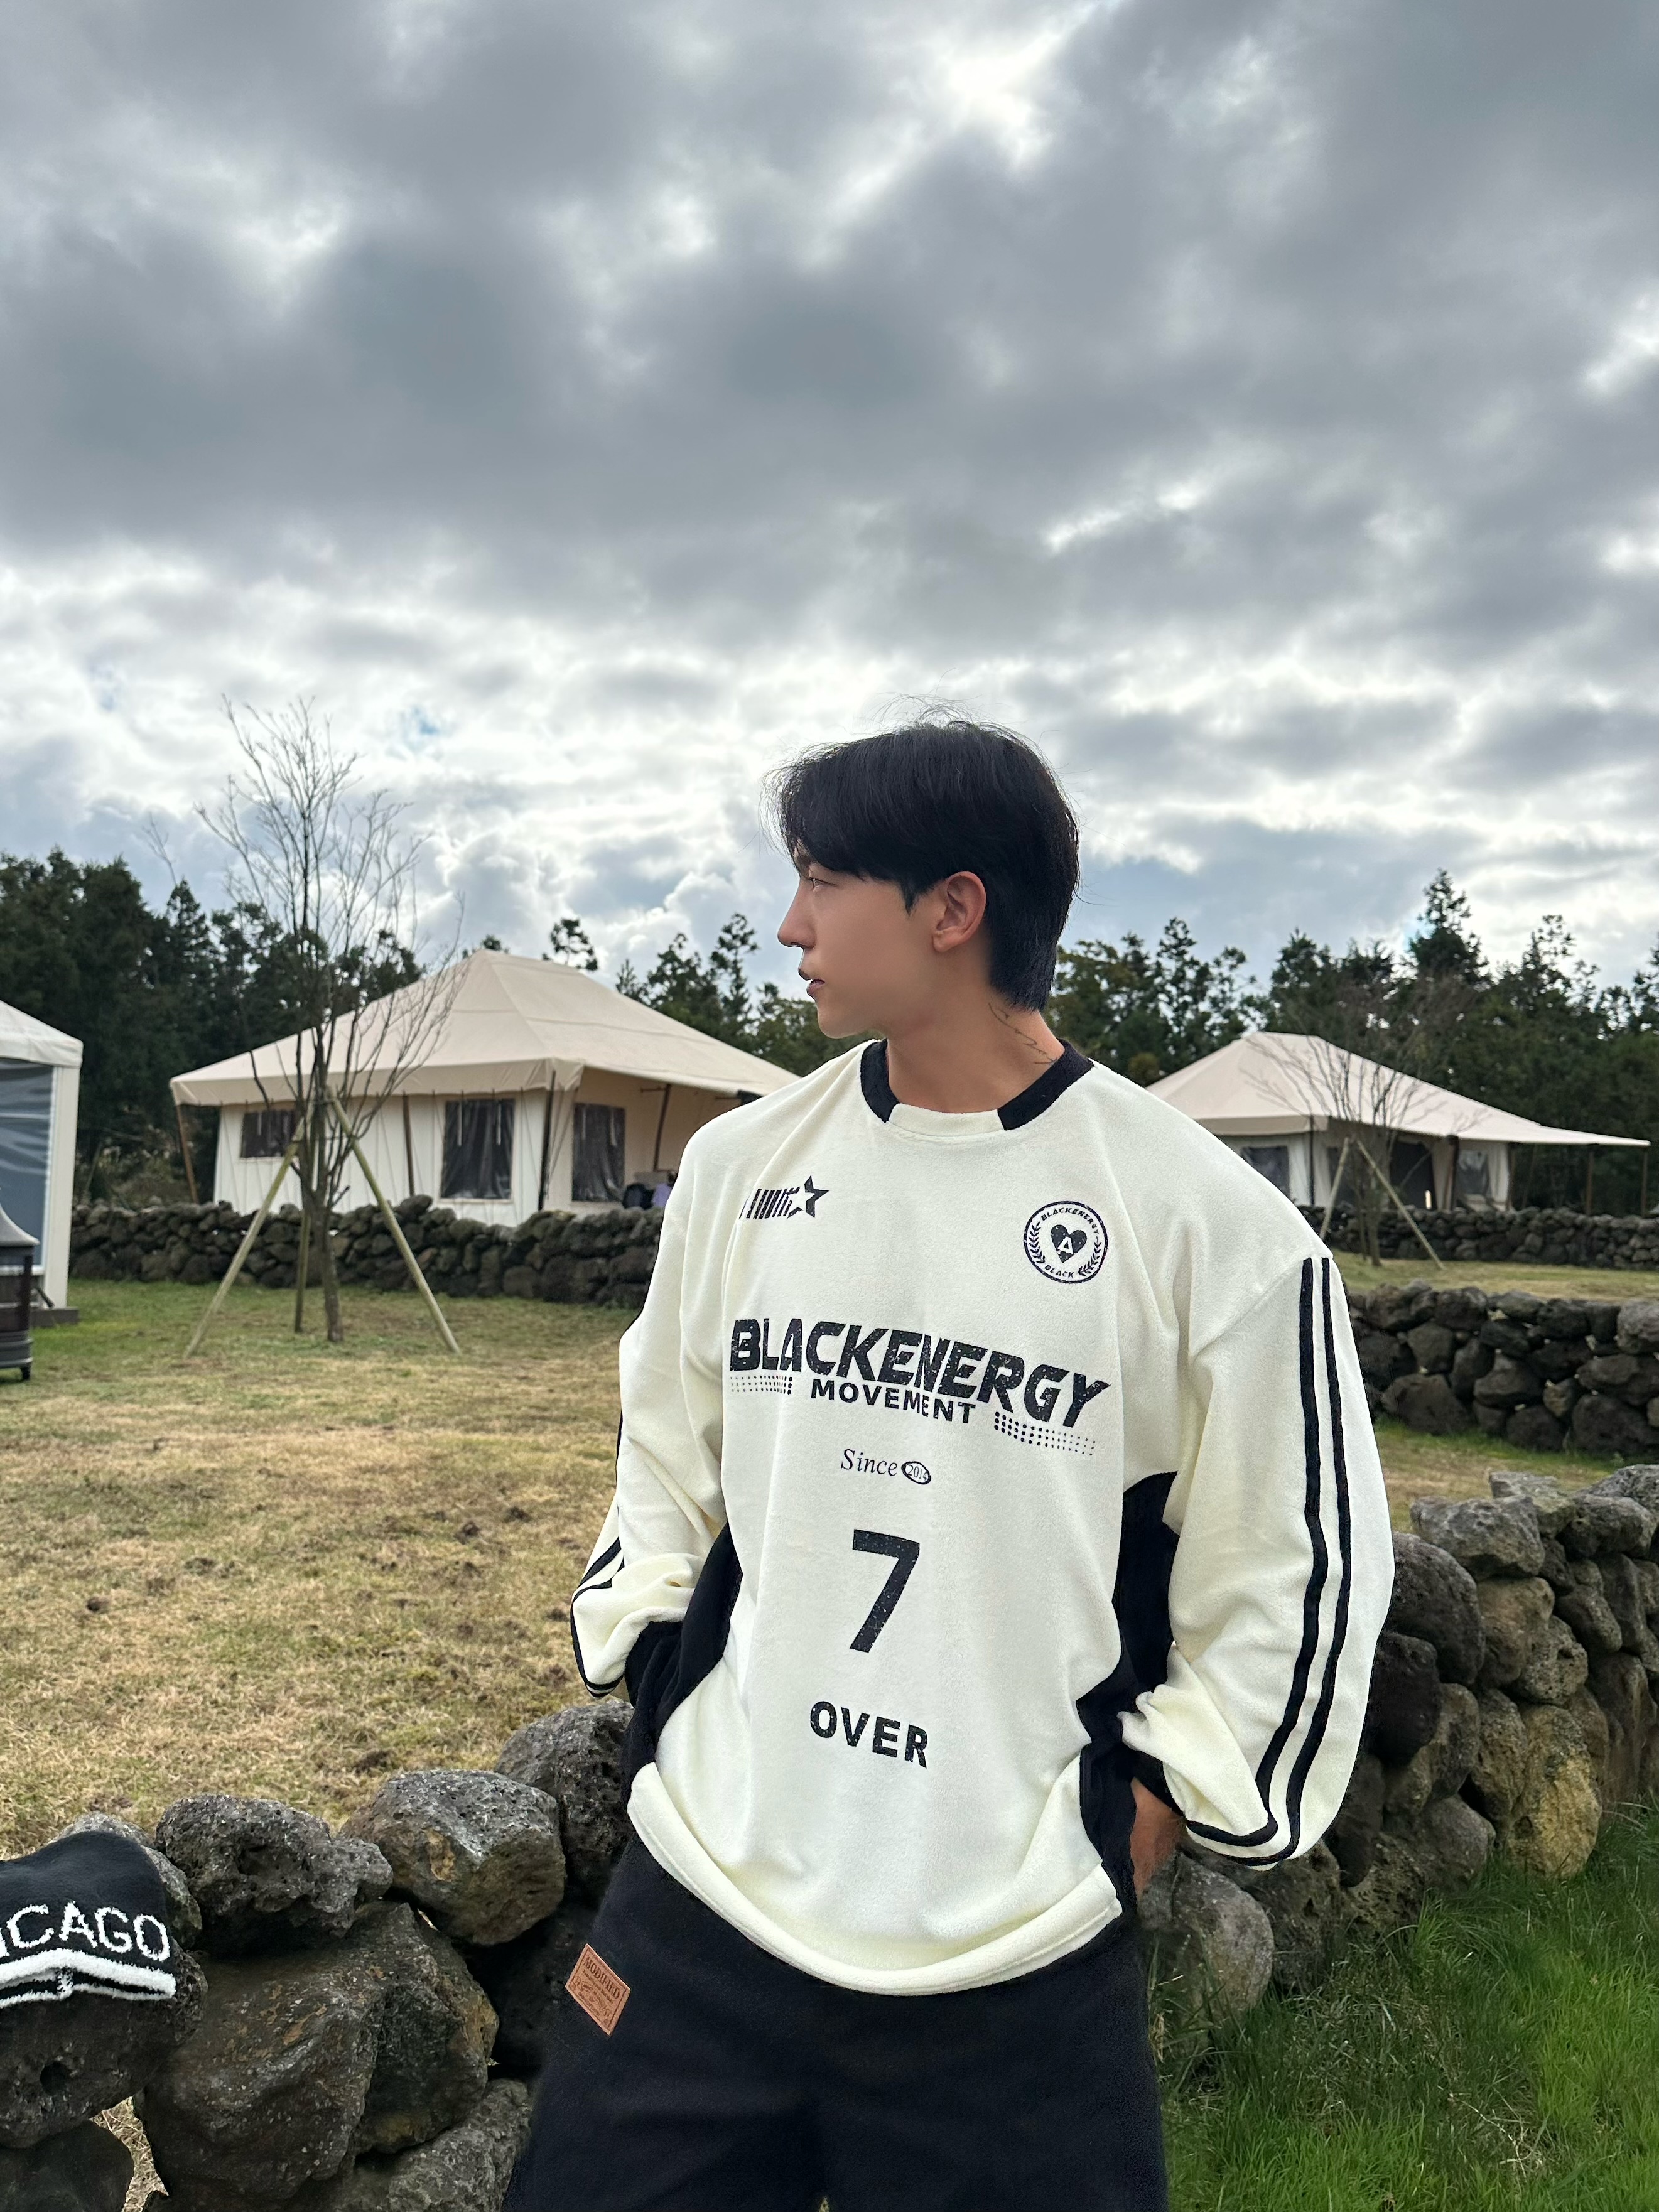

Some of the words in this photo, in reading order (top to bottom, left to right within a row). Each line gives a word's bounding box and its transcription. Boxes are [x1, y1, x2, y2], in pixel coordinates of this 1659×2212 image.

[1040, 1207, 1100, 1234] BLACKENERGY
[1044, 1265, 1074, 1278] BLACK
[730, 1317, 1111, 1428] BLACKENERGY
[811, 1378, 976, 1424] MOVEMENT
[840, 1449, 898, 1477] Since
[906, 1464, 928, 1481] 2014
[849, 1528, 920, 1653] 7
[810, 1700, 928, 1769] OVER
